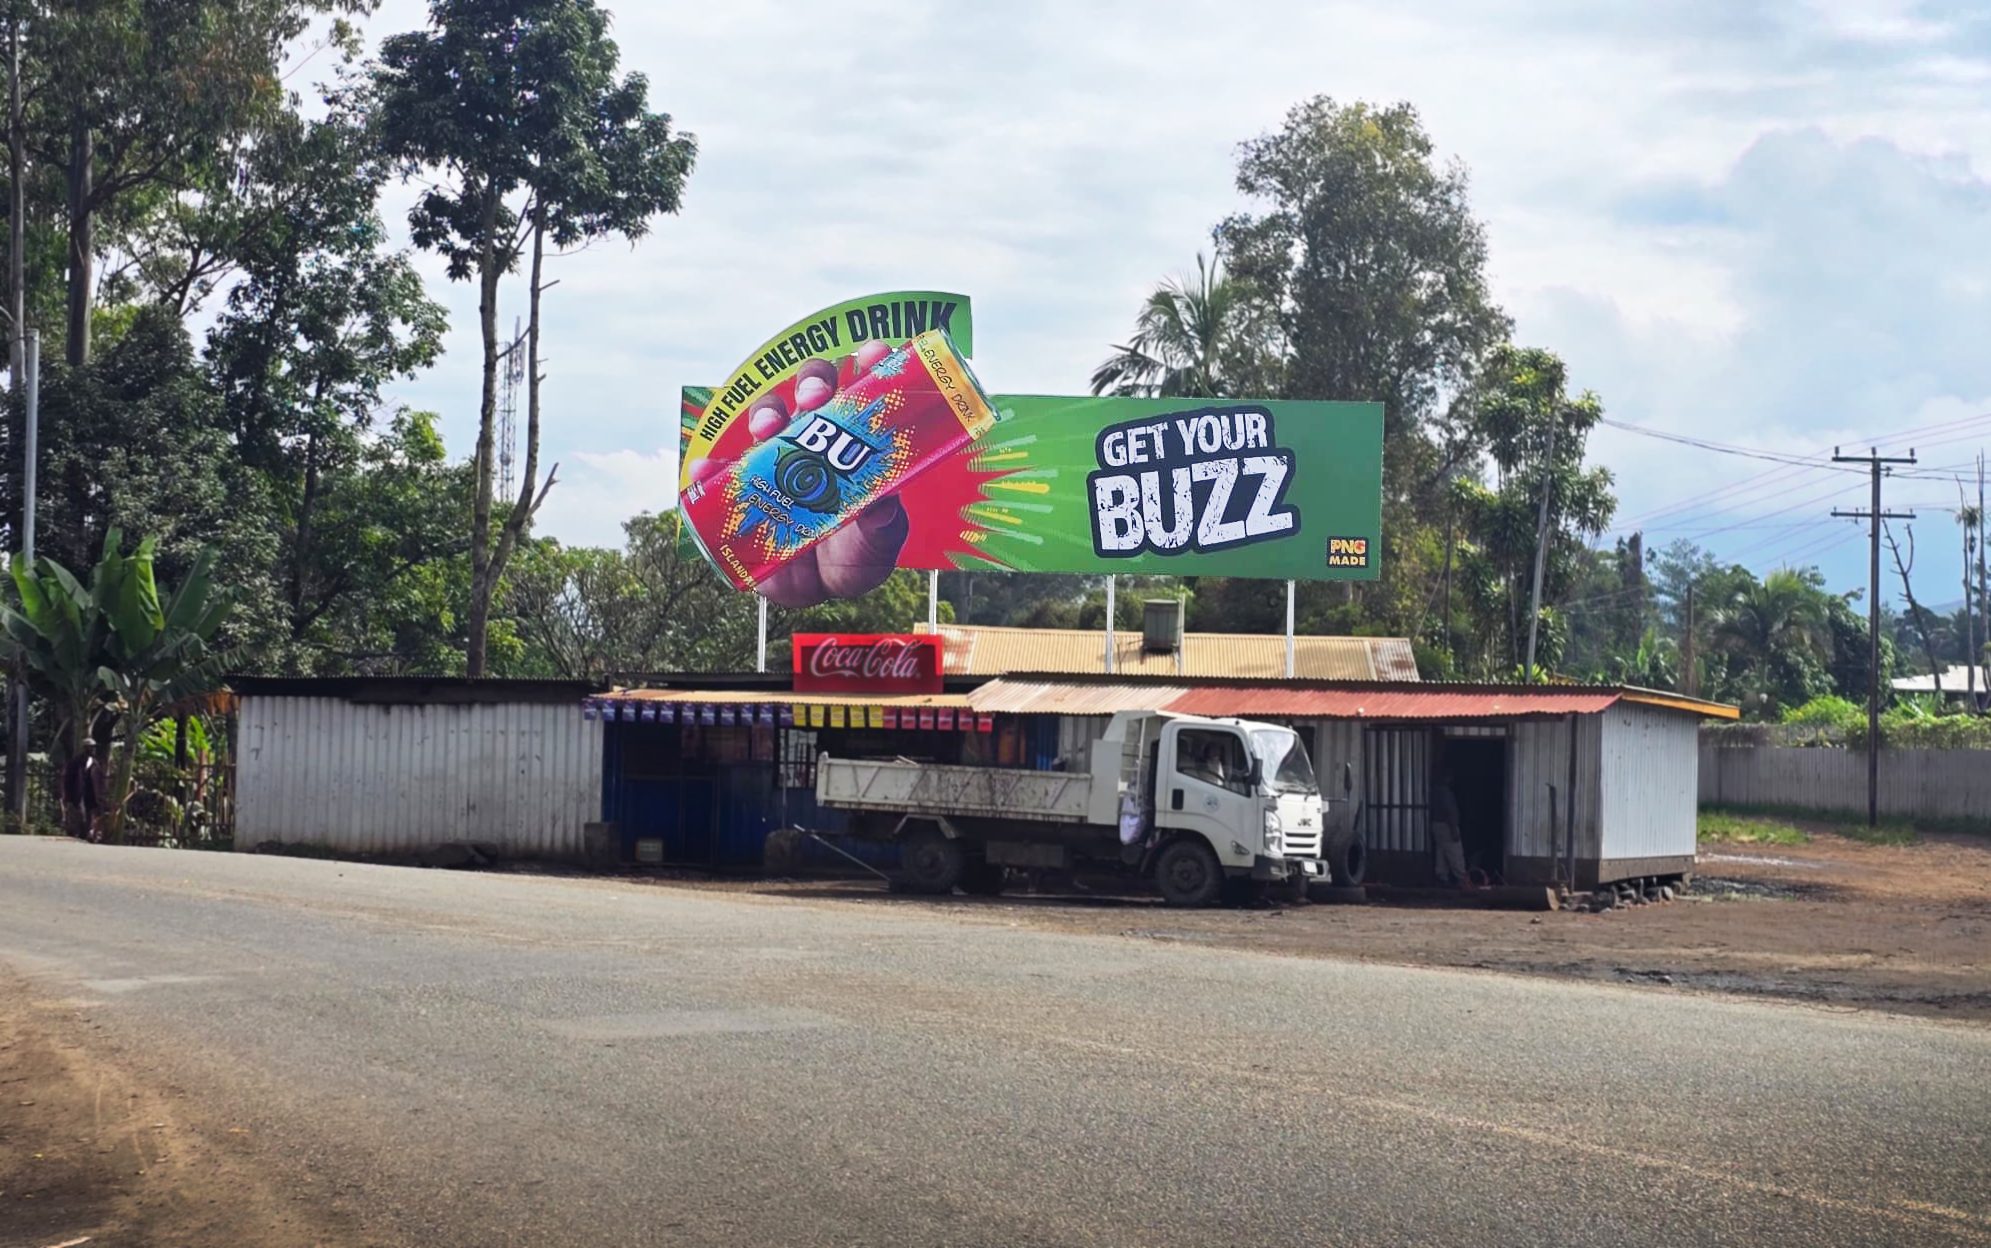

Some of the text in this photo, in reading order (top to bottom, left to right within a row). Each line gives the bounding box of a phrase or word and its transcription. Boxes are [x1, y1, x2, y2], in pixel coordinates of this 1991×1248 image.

[700, 300, 958, 441] HIGH FUEL ENERGY DRINK
[795, 415, 872, 472] BU
[1103, 412, 1268, 467] GET YOUR
[748, 494, 794, 526] ENERGY
[770, 490, 796, 510] FUEL
[1094, 455, 1294, 551] BUZZ
[1329, 555, 1366, 566] MADE
[1330, 539, 1366, 555] PNG
[810, 637, 923, 678] Coca-Cola
